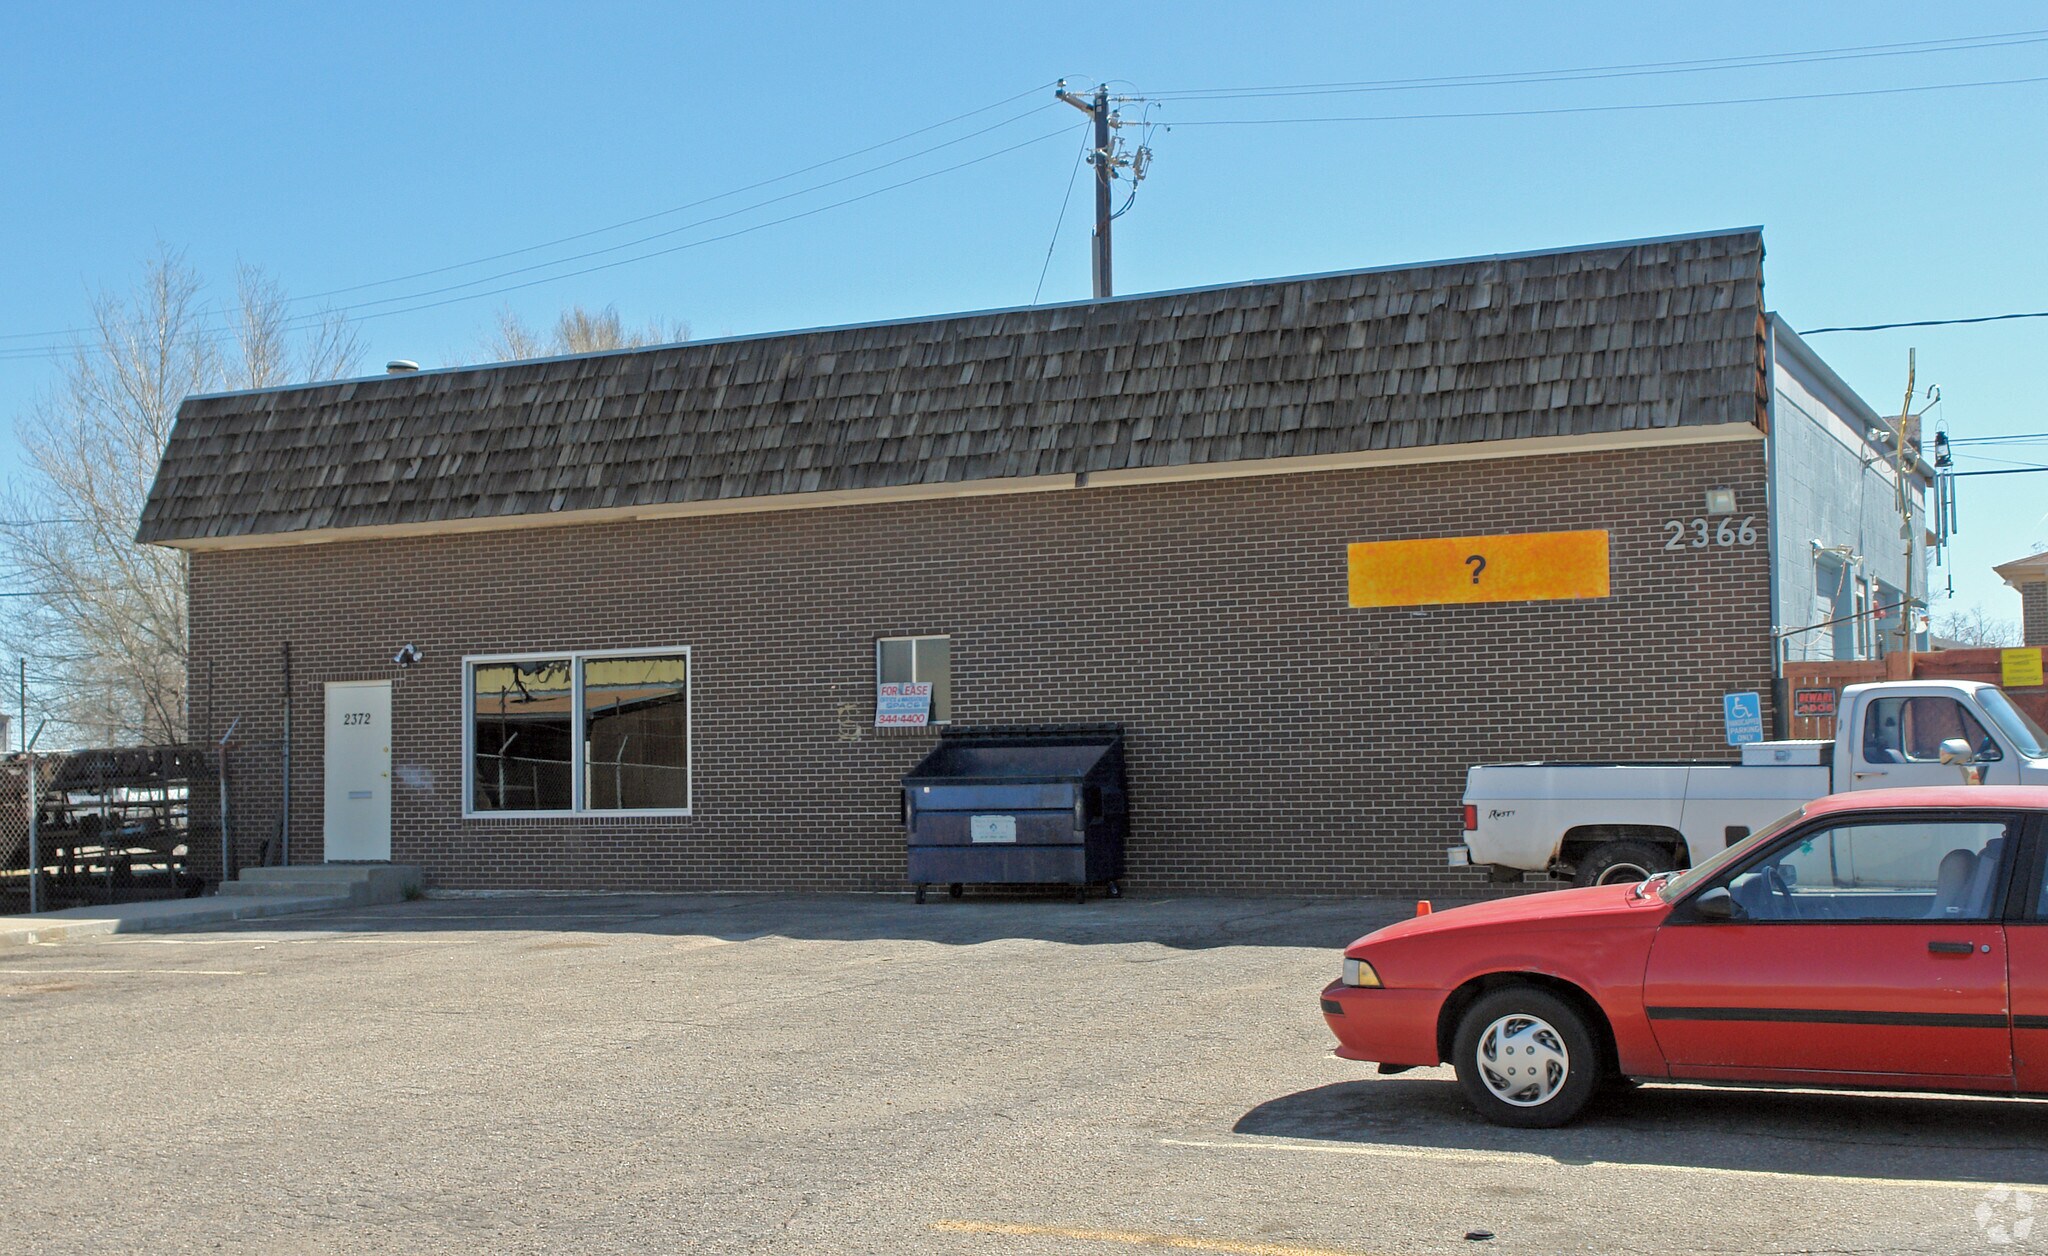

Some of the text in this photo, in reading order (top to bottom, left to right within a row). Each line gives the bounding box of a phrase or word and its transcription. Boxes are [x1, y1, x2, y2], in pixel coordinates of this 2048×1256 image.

[1664, 516, 1757, 550] 2366
[1465, 554, 1486, 585] ?
[881, 685, 928, 696] FOR LEASE
[1799, 692, 1833, 703] BEWARE
[1810, 704, 1833, 713] DOG
[343, 713, 371, 725] 2372
[1729, 726, 1761, 735] PARKING
